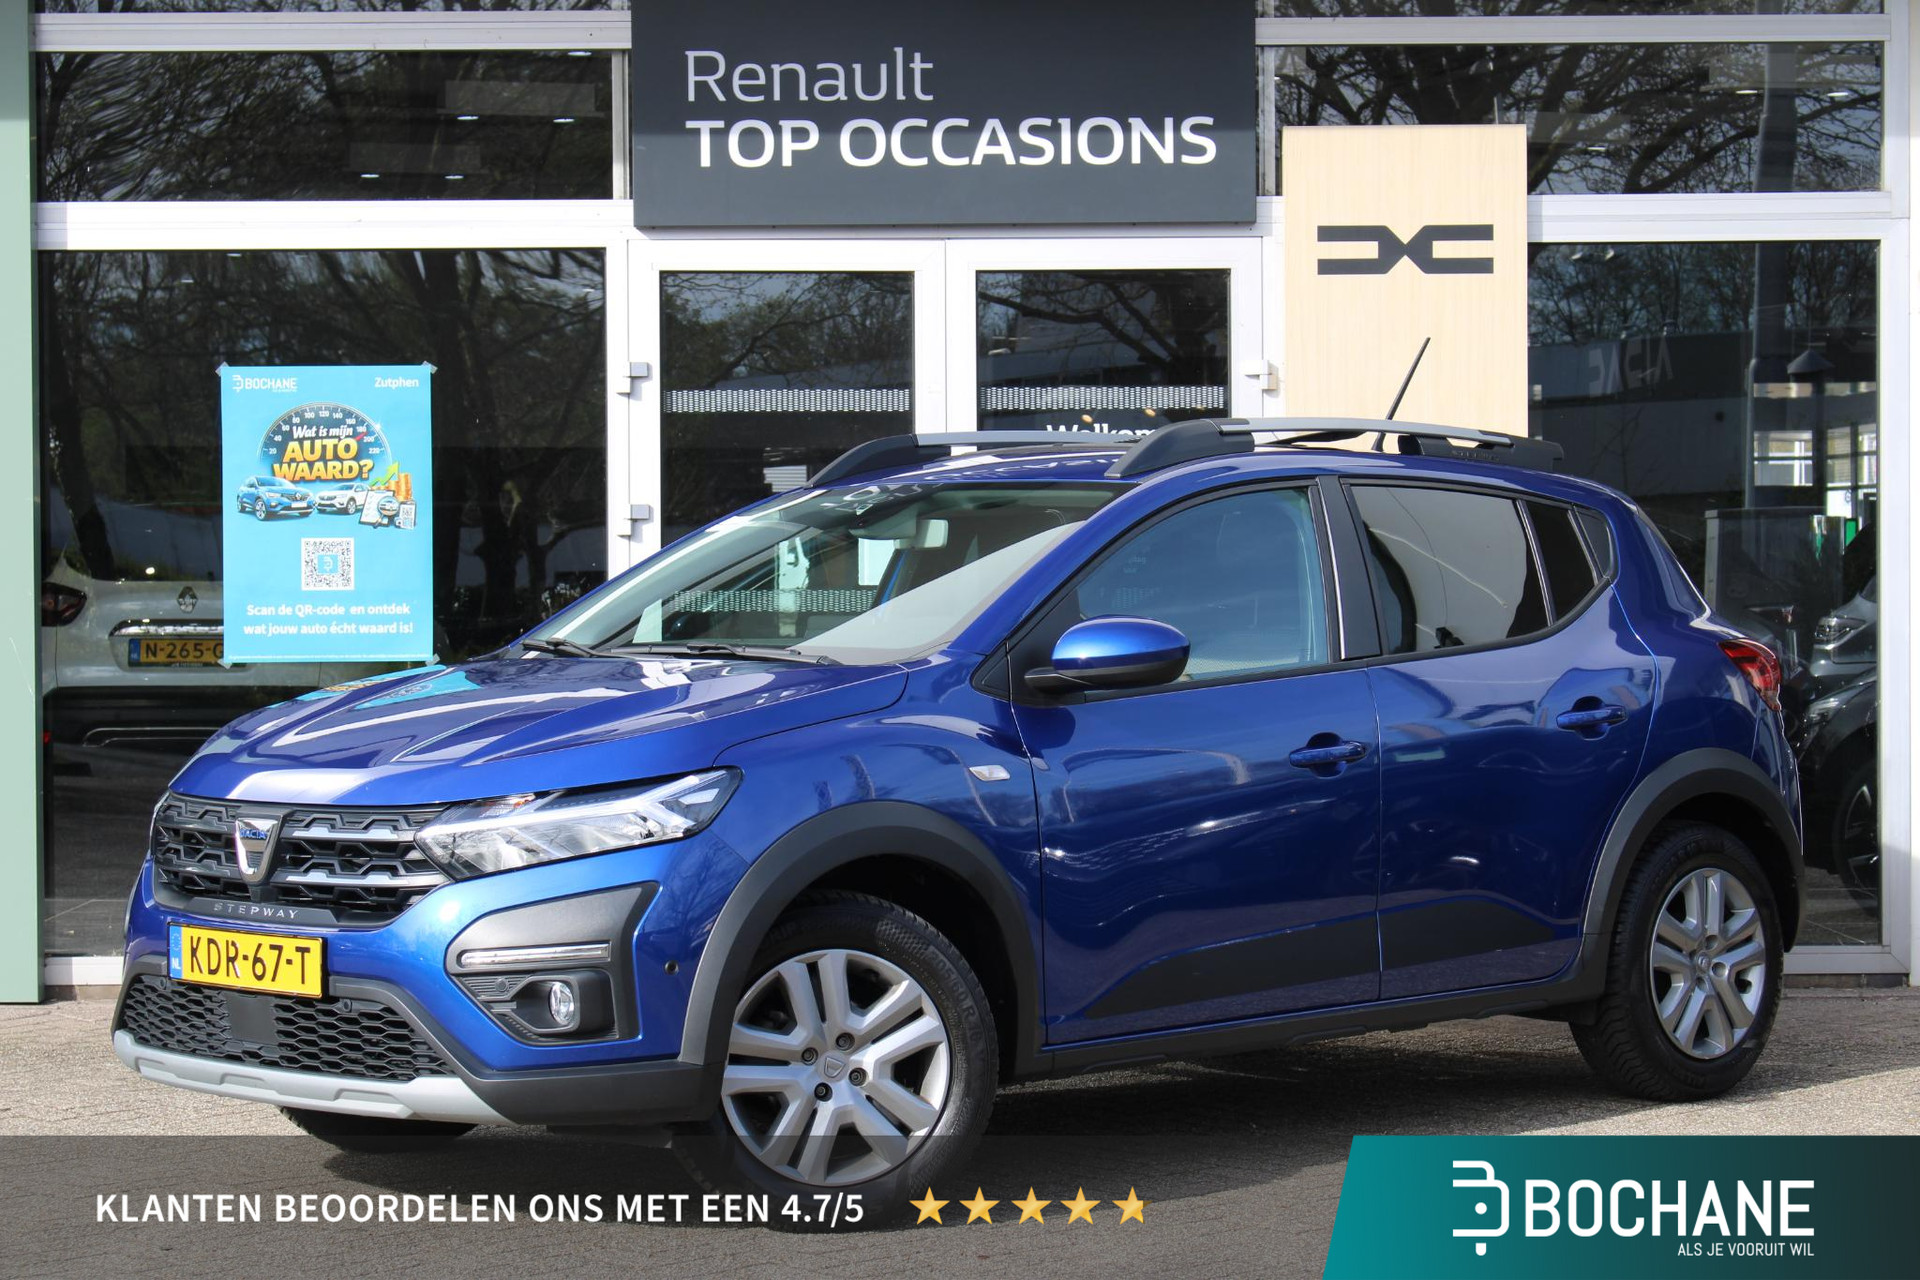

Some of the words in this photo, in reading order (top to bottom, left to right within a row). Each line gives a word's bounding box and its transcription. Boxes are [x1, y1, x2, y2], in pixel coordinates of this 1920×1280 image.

[685, 47, 934, 103] Renault
[685, 118, 820, 167] TOP
[839, 115, 1218, 166] OCCASIONS
[245, 377, 298, 389] BOCHANE
[374, 376, 420, 390] Zutphen
[269, 447, 277, 455] 20
[273, 434, 283, 442] 40
[304, 411, 316, 419] 100
[318, 410, 330, 418] 120
[332, 411, 343, 420] 140
[292, 425, 316, 439] Wat
[319, 425, 327, 437] is
[329, 424, 353, 440] mijn
[282, 438, 358, 463] AUTO
[273, 459, 374, 482] WAARD?
[246, 603, 276, 616] Scan
[278, 603, 293, 616] de
[295, 603, 346, 618] QR-code
[350, 604, 365, 616] en
[367, 602, 411, 615] ontdek
[243, 624, 267, 636] wat
[267, 623, 298, 638] jouw
[300, 623, 328, 635] auto
[329, 621, 356, 635] écht
[359, 621, 396, 635] waard
[399, 621, 414, 634] is!
[145, 642, 224, 659] N-265-G
[240, 829, 268, 839] DACIA
[213, 902, 299, 920] STEPWAY
[171, 956, 182, 970] NL
[189, 934, 312, 985] KDR-67-T
